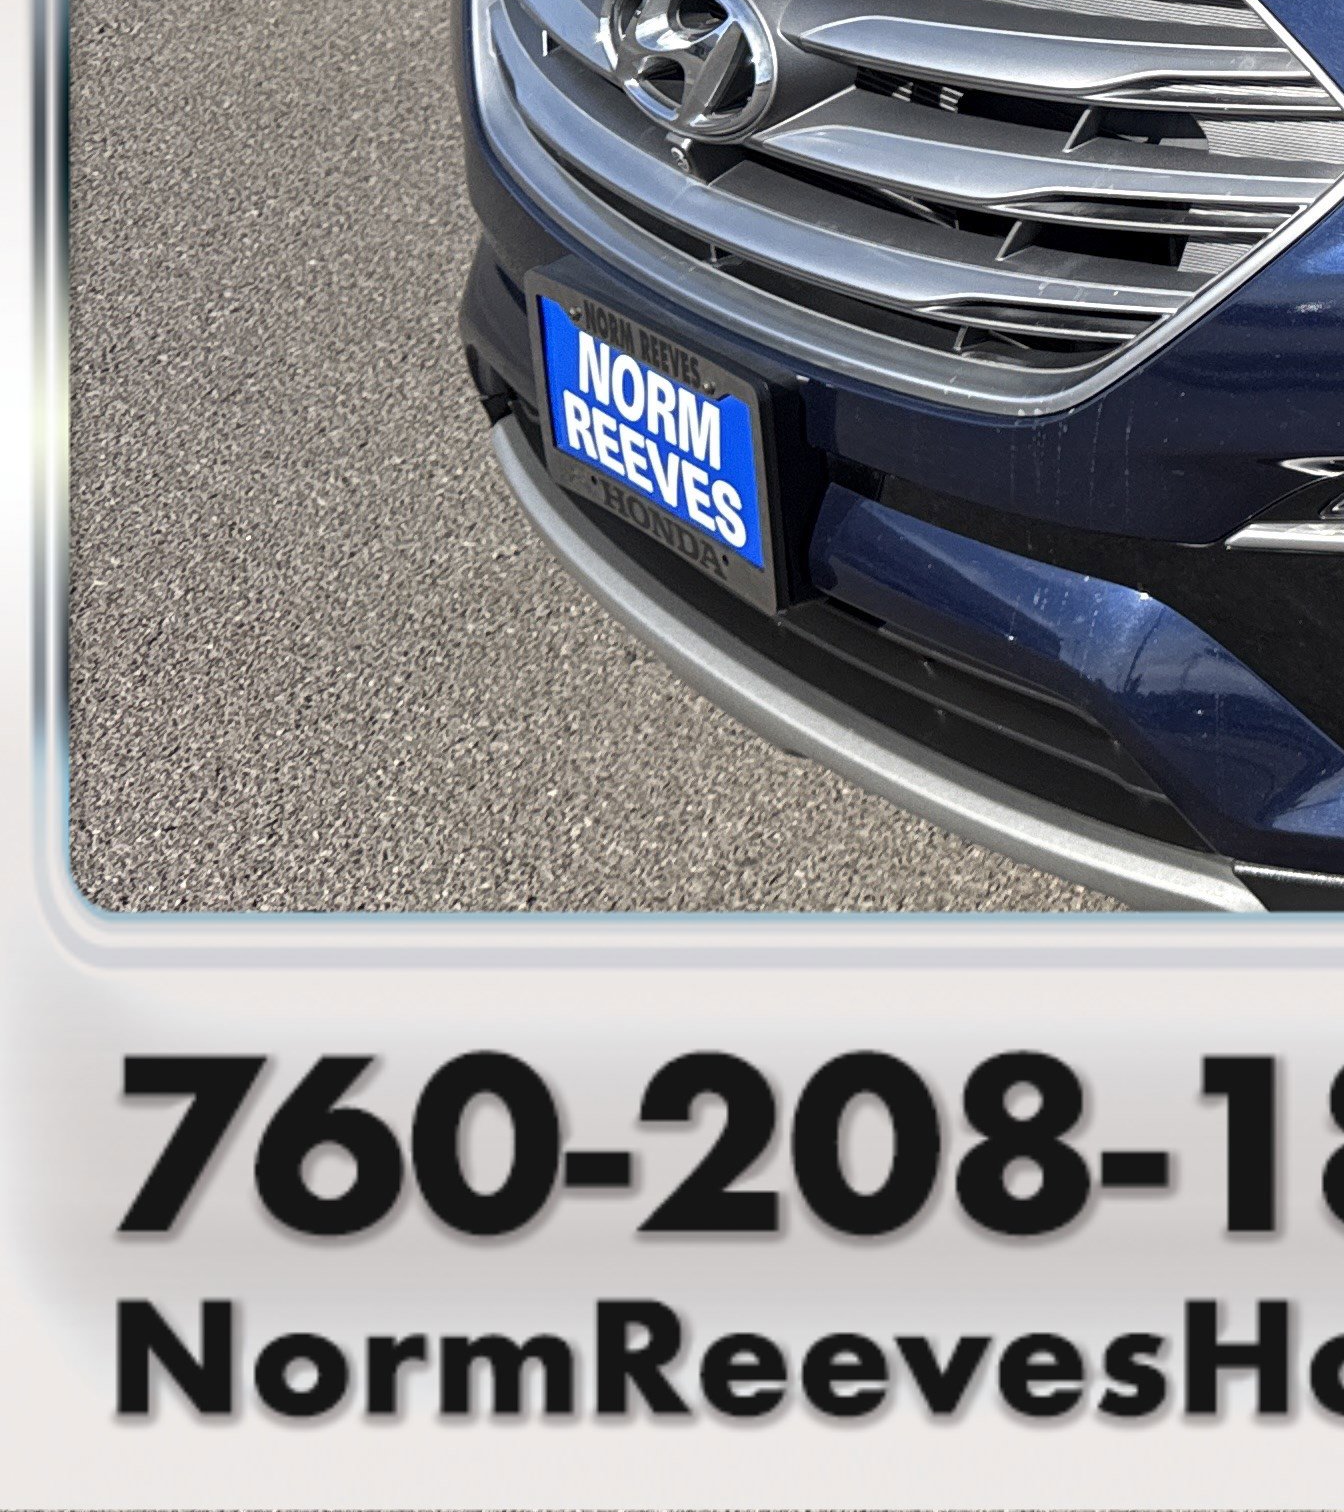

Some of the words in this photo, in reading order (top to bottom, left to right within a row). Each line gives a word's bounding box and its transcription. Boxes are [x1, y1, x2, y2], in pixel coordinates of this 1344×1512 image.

[578, 330, 721, 471] NORM
[583, 299, 635, 355] NORM
[638, 328, 702, 390] REEVES
[563, 389, 747, 548] REEVES
[600, 479, 728, 580] HONDA
